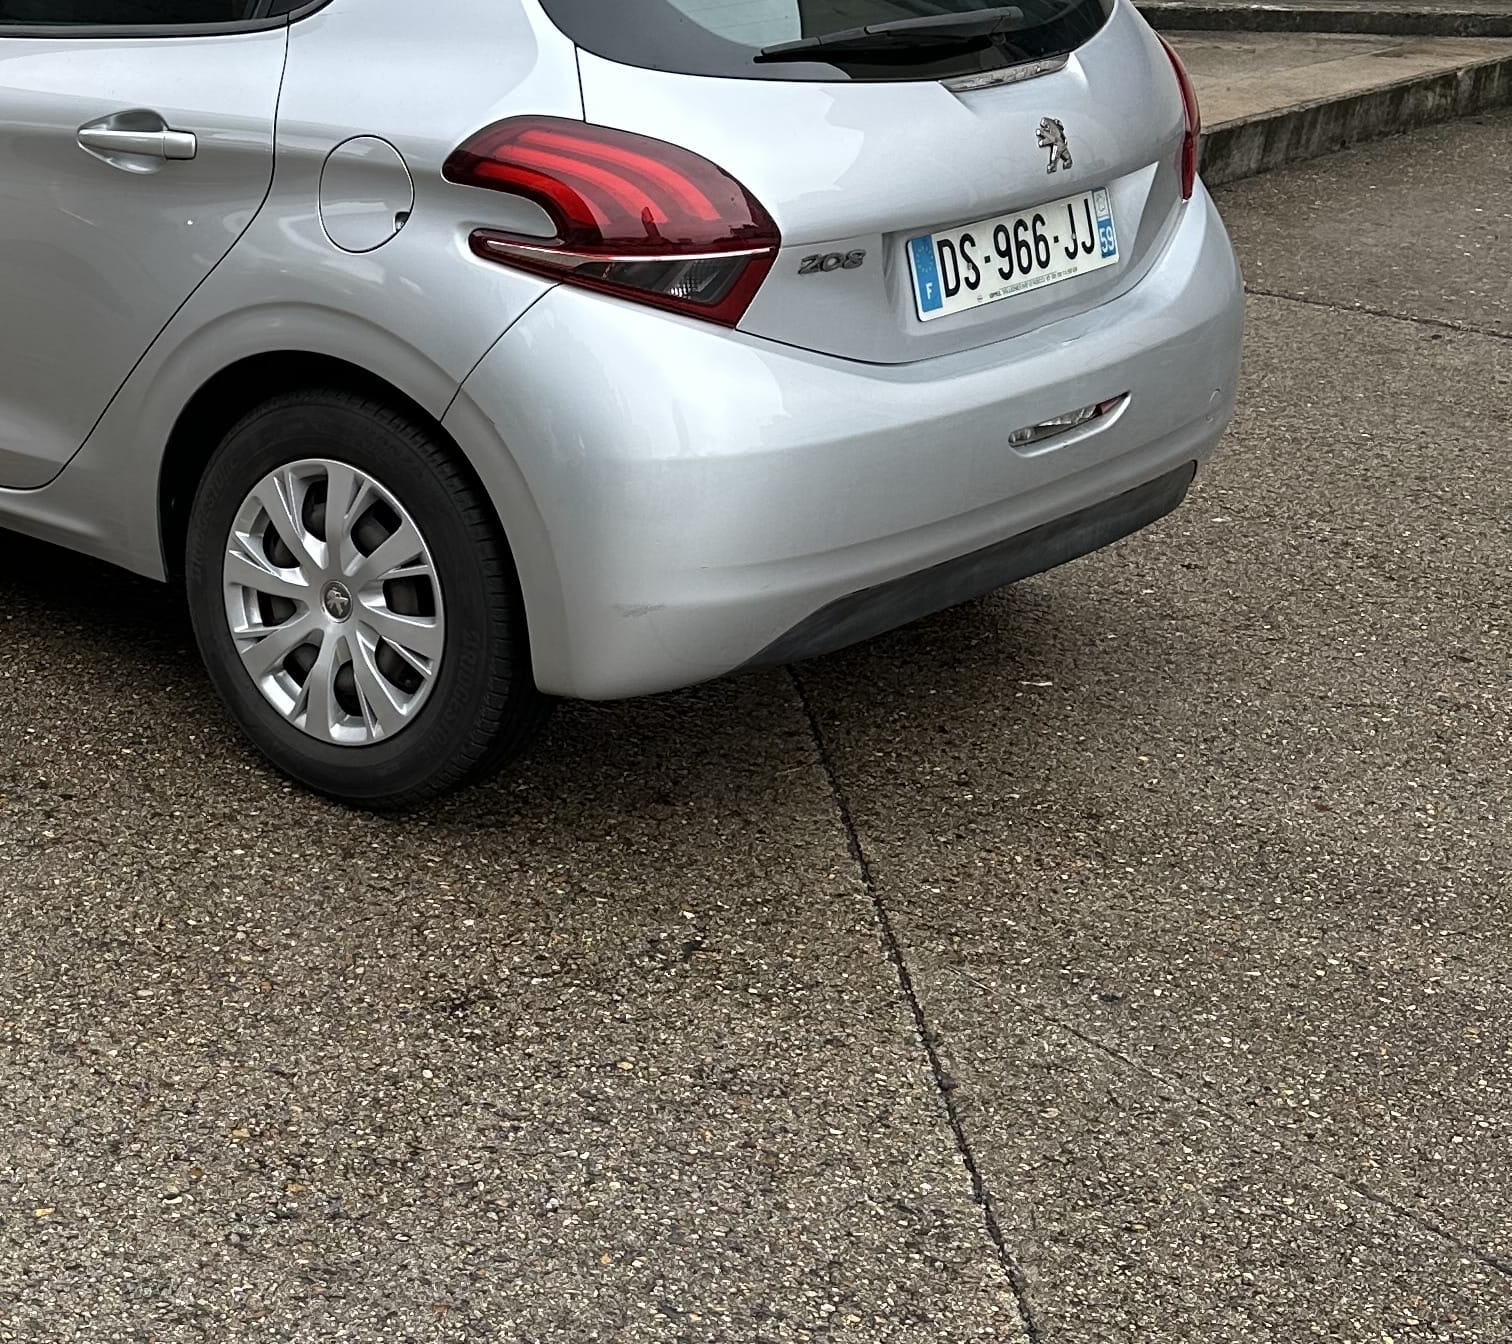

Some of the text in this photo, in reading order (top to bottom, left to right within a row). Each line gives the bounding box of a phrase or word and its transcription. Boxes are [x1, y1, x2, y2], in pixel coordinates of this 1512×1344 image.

[936, 198, 1095, 298] DS-966-JJ
[1099, 226, 1115, 253] 59
[798, 249, 866, 274] 208
[925, 282, 933, 300] F
